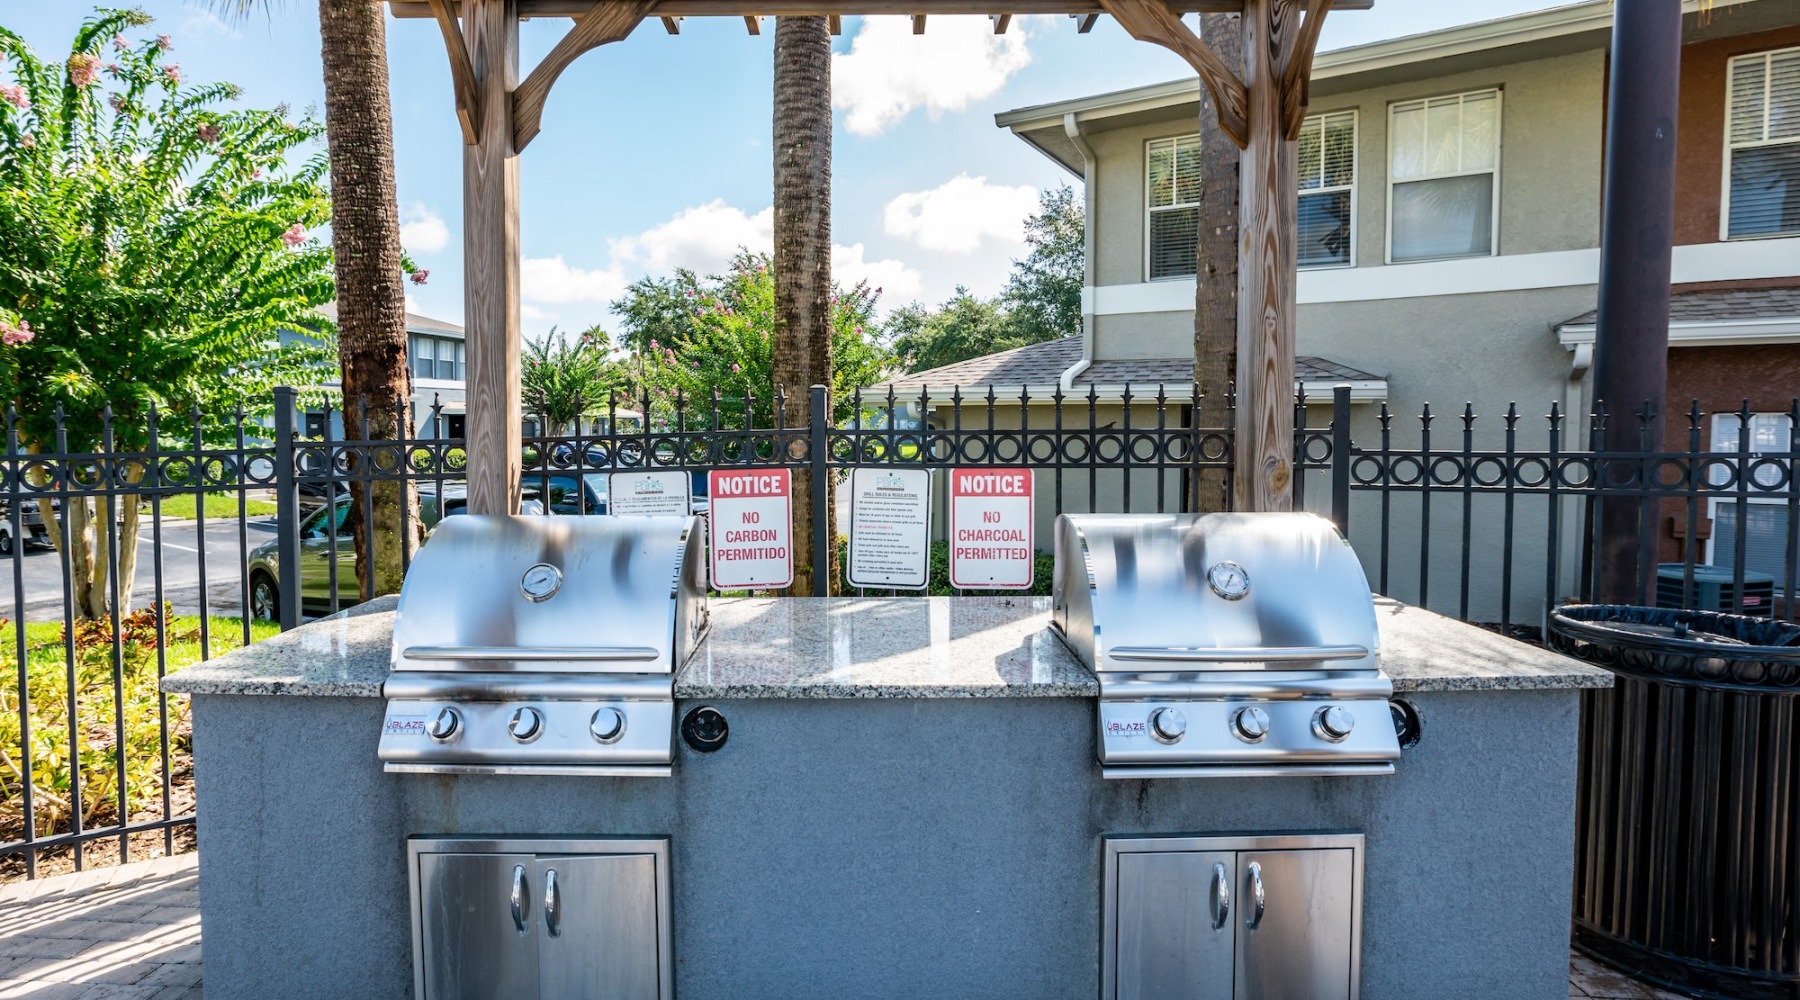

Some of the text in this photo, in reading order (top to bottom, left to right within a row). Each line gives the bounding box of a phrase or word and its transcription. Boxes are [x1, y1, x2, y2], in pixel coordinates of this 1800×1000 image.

[718, 476, 782, 495] NOTICE
[960, 475, 1024, 494] NOTICE
[742, 512, 760, 524] NO
[983, 511, 1001, 523] NO
[725, 529, 777, 543] CARBON
[958, 529, 1026, 542] CHARCOAL
[717, 547, 786, 561] PERMITIDO
[956, 547, 1028, 560] PERMITTED
[391, 721, 424, 729] BLAZE
[1112, 723, 1145, 731] BLAZE
